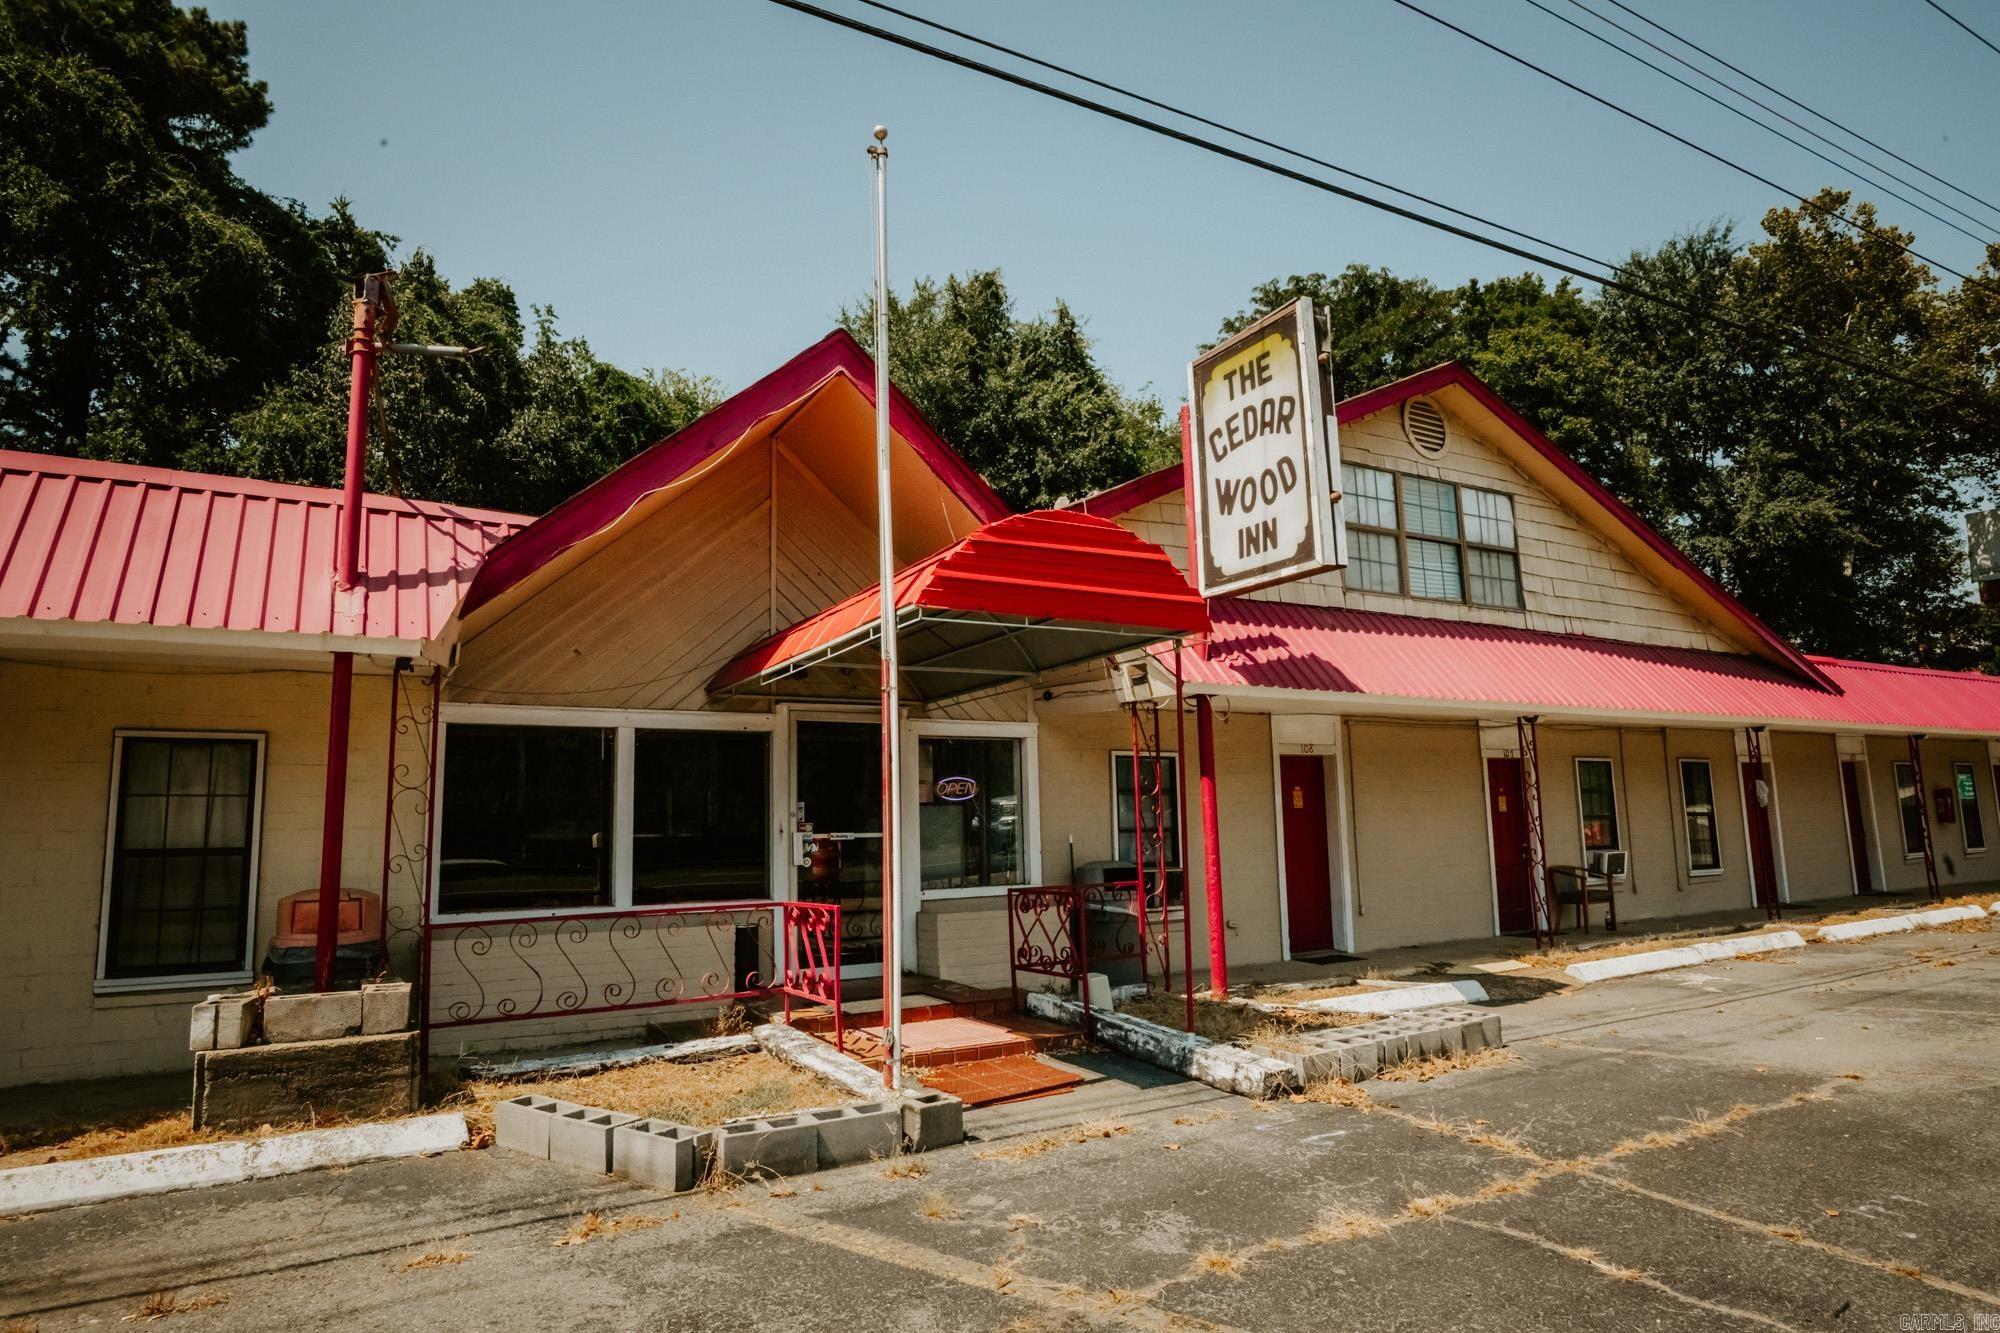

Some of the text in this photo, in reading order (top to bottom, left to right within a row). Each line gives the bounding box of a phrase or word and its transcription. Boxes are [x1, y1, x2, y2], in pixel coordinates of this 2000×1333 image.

[1223, 350, 1273, 401] THE
[1208, 395, 1296, 463] CEDAR
[1215, 455, 1297, 516] WOOD
[1238, 517, 1278, 560] INN
[1300, 743, 1314, 754] 108
[936, 782, 976, 795] OPEN
